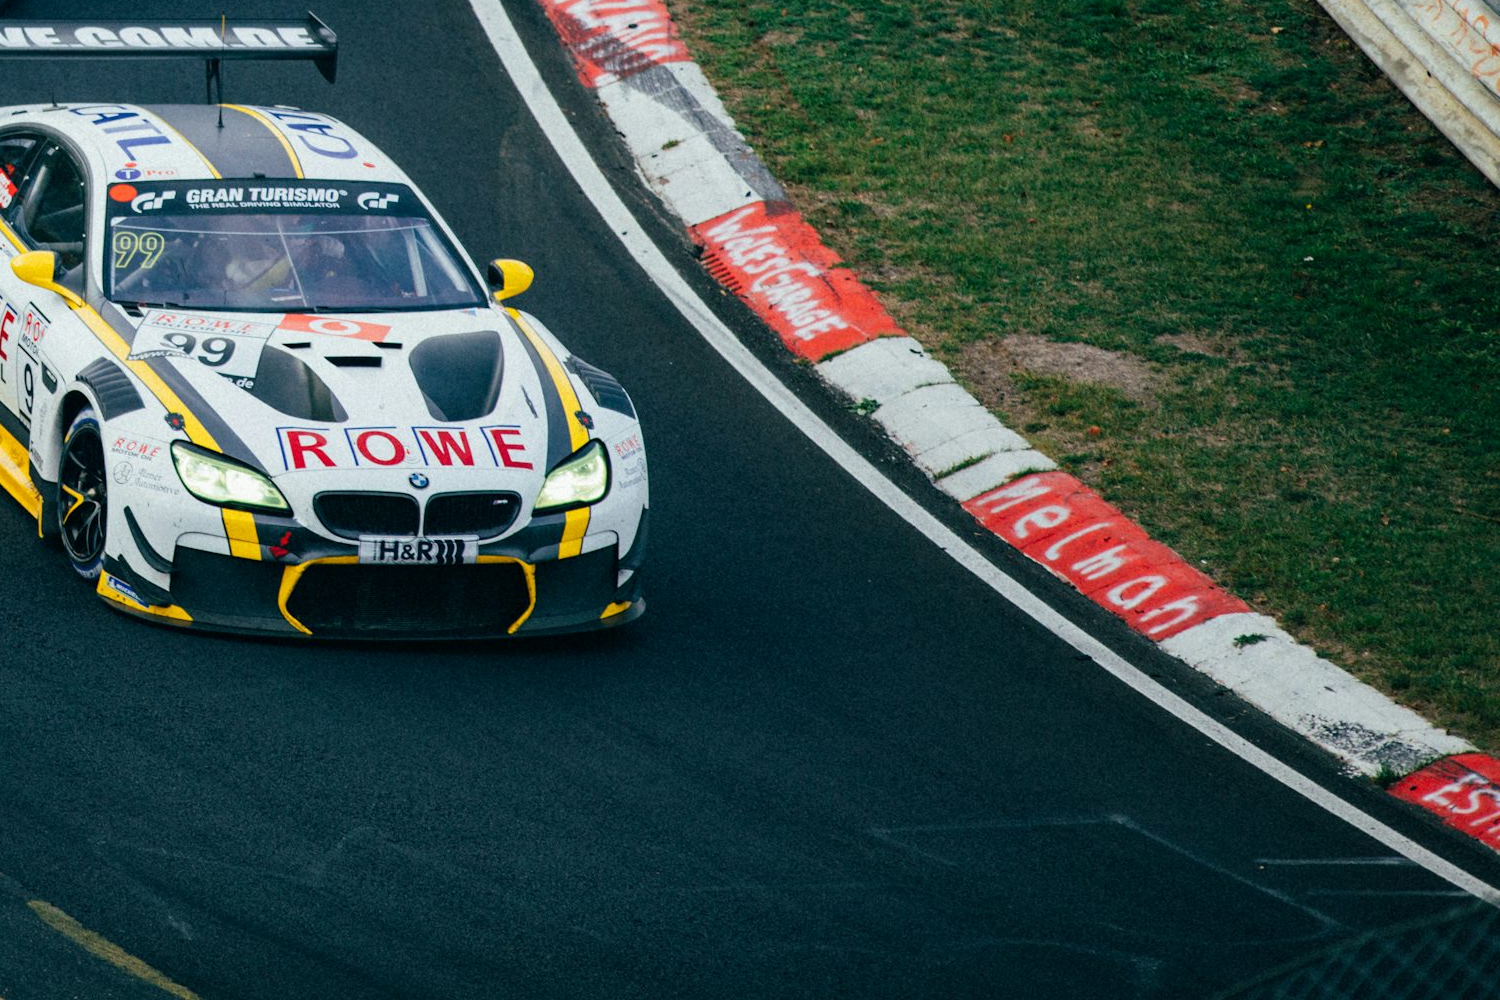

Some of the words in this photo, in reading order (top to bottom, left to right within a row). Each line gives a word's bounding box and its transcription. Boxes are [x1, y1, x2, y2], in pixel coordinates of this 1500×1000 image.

[186, 187, 244, 204] GRAN
[189, 202, 210, 210] THE
[282, 201, 340, 209] SIMULATOR
[112, 231, 165, 269] 99
[162, 332, 236, 367] 99
[115, 437, 160, 457] ROWE
[286, 429, 534, 471] ROWE
